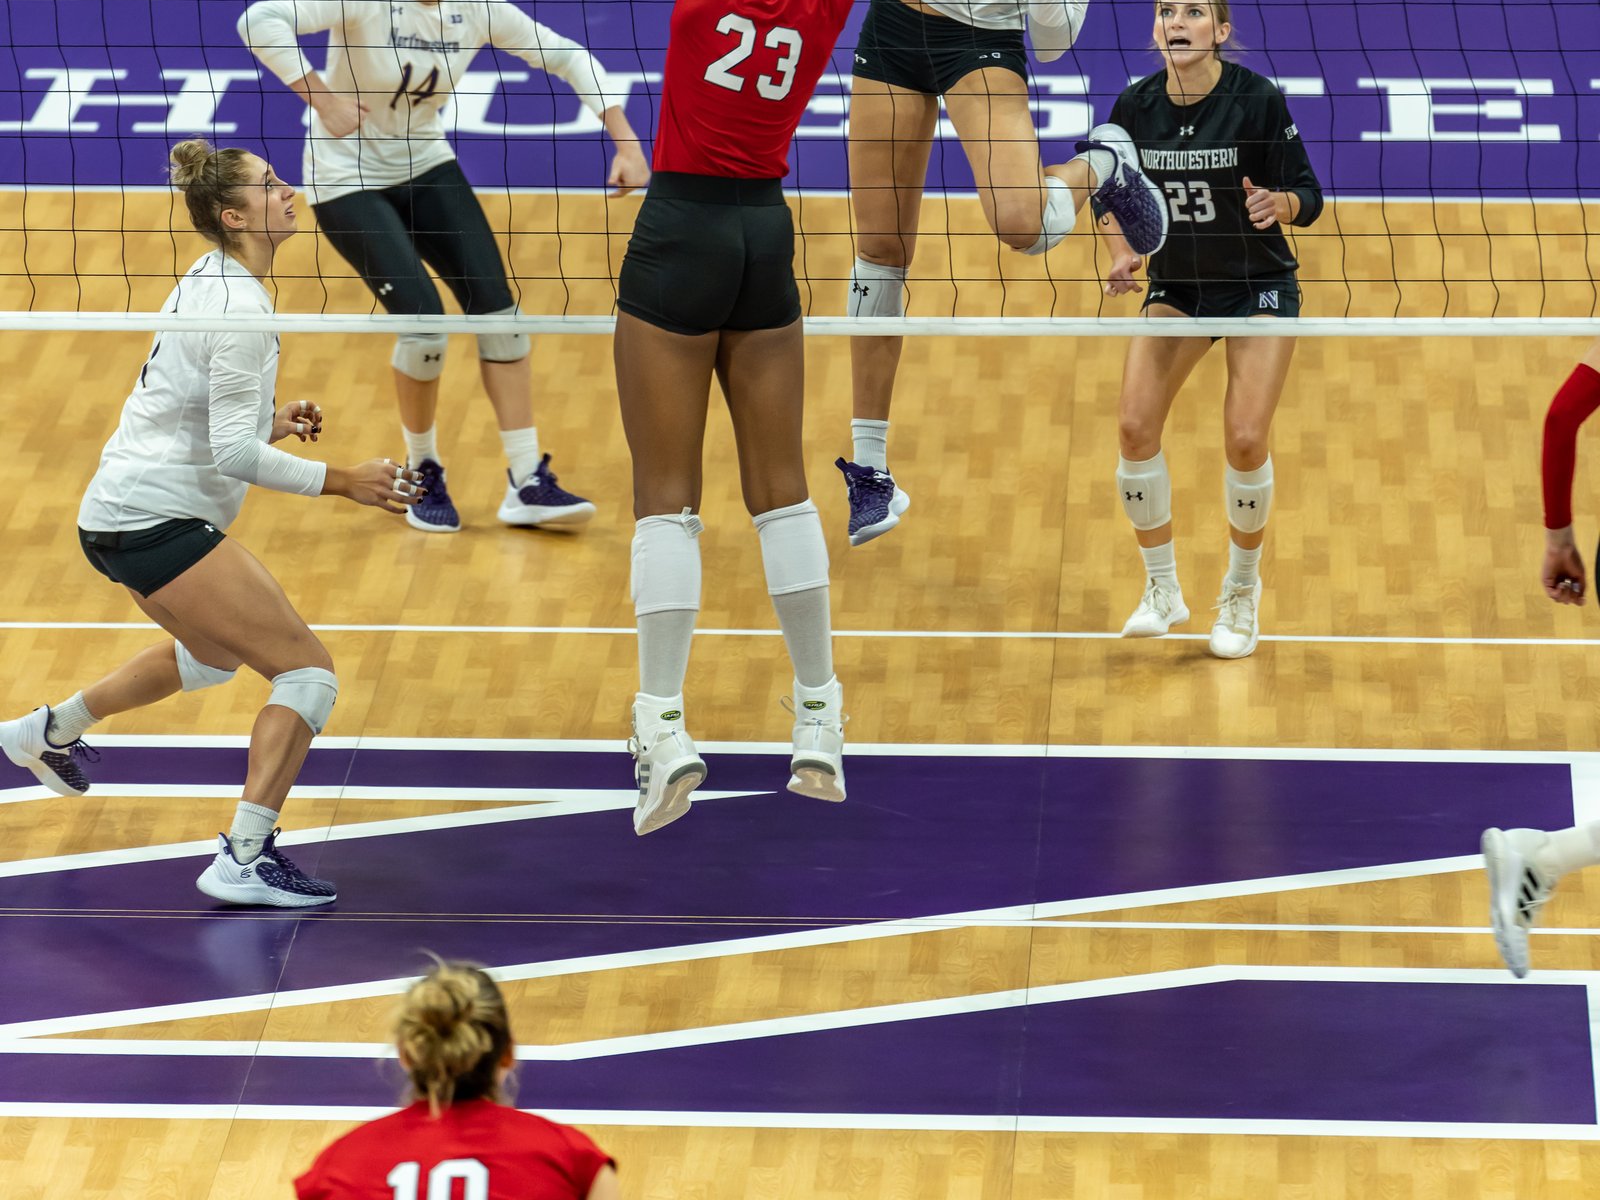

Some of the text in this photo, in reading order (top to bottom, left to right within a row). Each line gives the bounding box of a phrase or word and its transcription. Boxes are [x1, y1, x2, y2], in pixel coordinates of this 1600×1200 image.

[704, 13, 803, 101] 23
[389, 62, 440, 111] 14
[1139, 147, 1238, 170] NORTHWESTERN
[1164, 181, 1216, 222] 23
[1259, 290, 1279, 309] N
